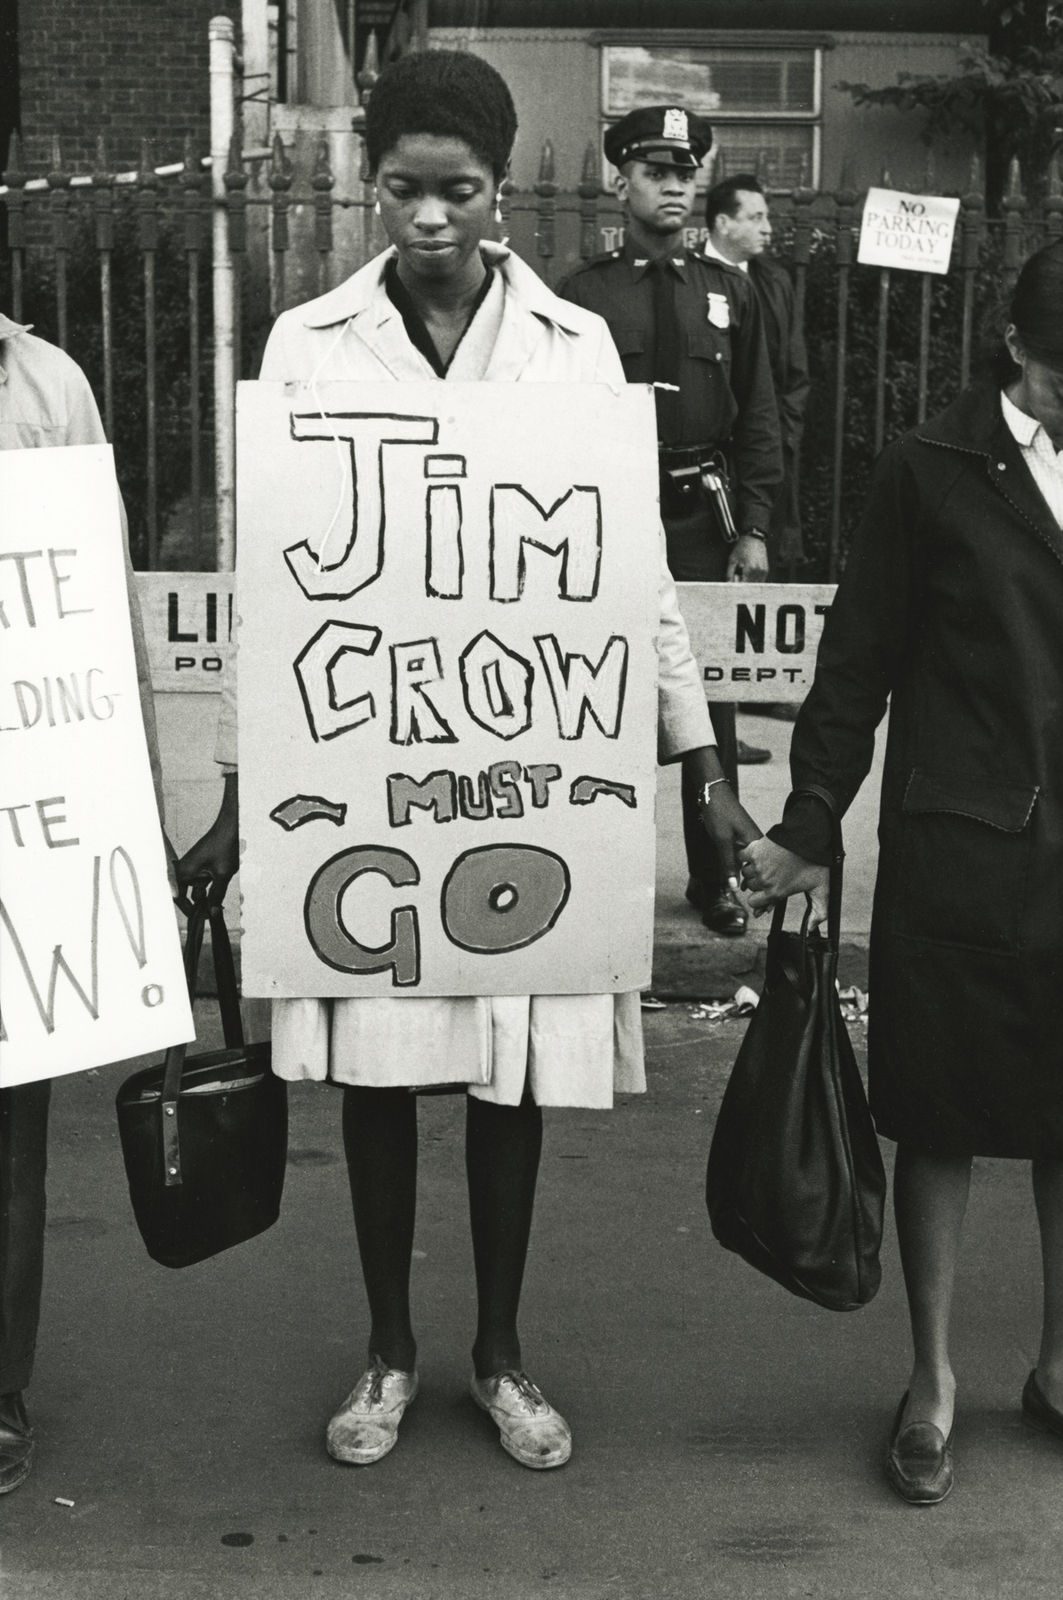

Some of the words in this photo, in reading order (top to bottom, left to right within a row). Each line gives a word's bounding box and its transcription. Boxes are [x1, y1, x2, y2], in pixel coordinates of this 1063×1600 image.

[866, 212, 949, 239] PARKING
[898, 200, 927, 217] NO
[875, 230, 938, 253] TODAY
[168, 592, 233, 643] LI
[0, 668, 121, 731] DING
[293, 620, 629, 746] CROW
[703, 666, 806, 684] DEPT.
[386, 760, 562, 829] MUST
[303, 842, 572, 988] GO
